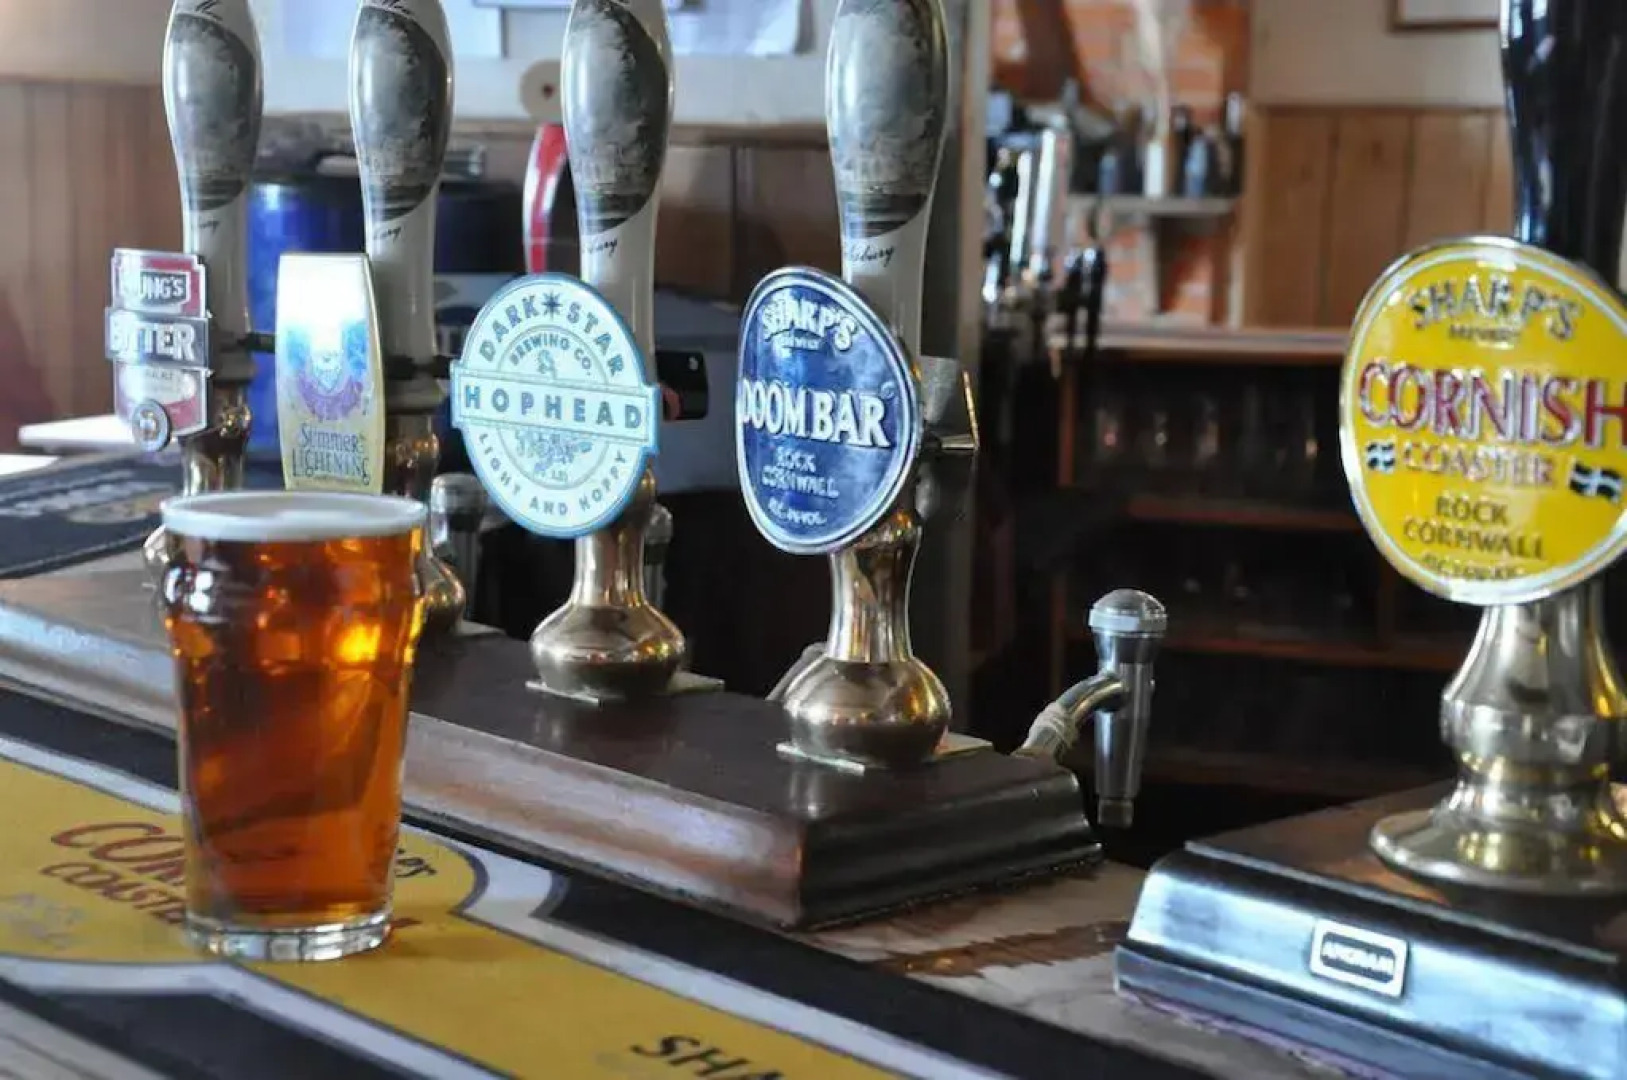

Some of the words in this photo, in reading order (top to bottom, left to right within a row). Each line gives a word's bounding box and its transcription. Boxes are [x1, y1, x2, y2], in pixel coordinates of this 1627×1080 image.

[479, 293, 540, 362] DARK
[567, 301, 625, 378] STAR
[762, 288, 859, 352] SHARP'S
[1409, 273, 1583, 341] SHARP'S
[510, 332, 571, 367] BREWING
[465, 385, 642, 429] HOPHEAD
[810, 388, 892, 448] BAR
[1358, 361, 1627, 447] CORNISH
[478, 432, 521, 495] LIGHT
[529, 495, 569, 517] AND
[578, 448, 627, 512] HOPPY
[1402, 442, 1556, 489] COASTER
[1402, 514, 1546, 560] CORNWALL
[1435, 492, 1510, 526] ROCK
